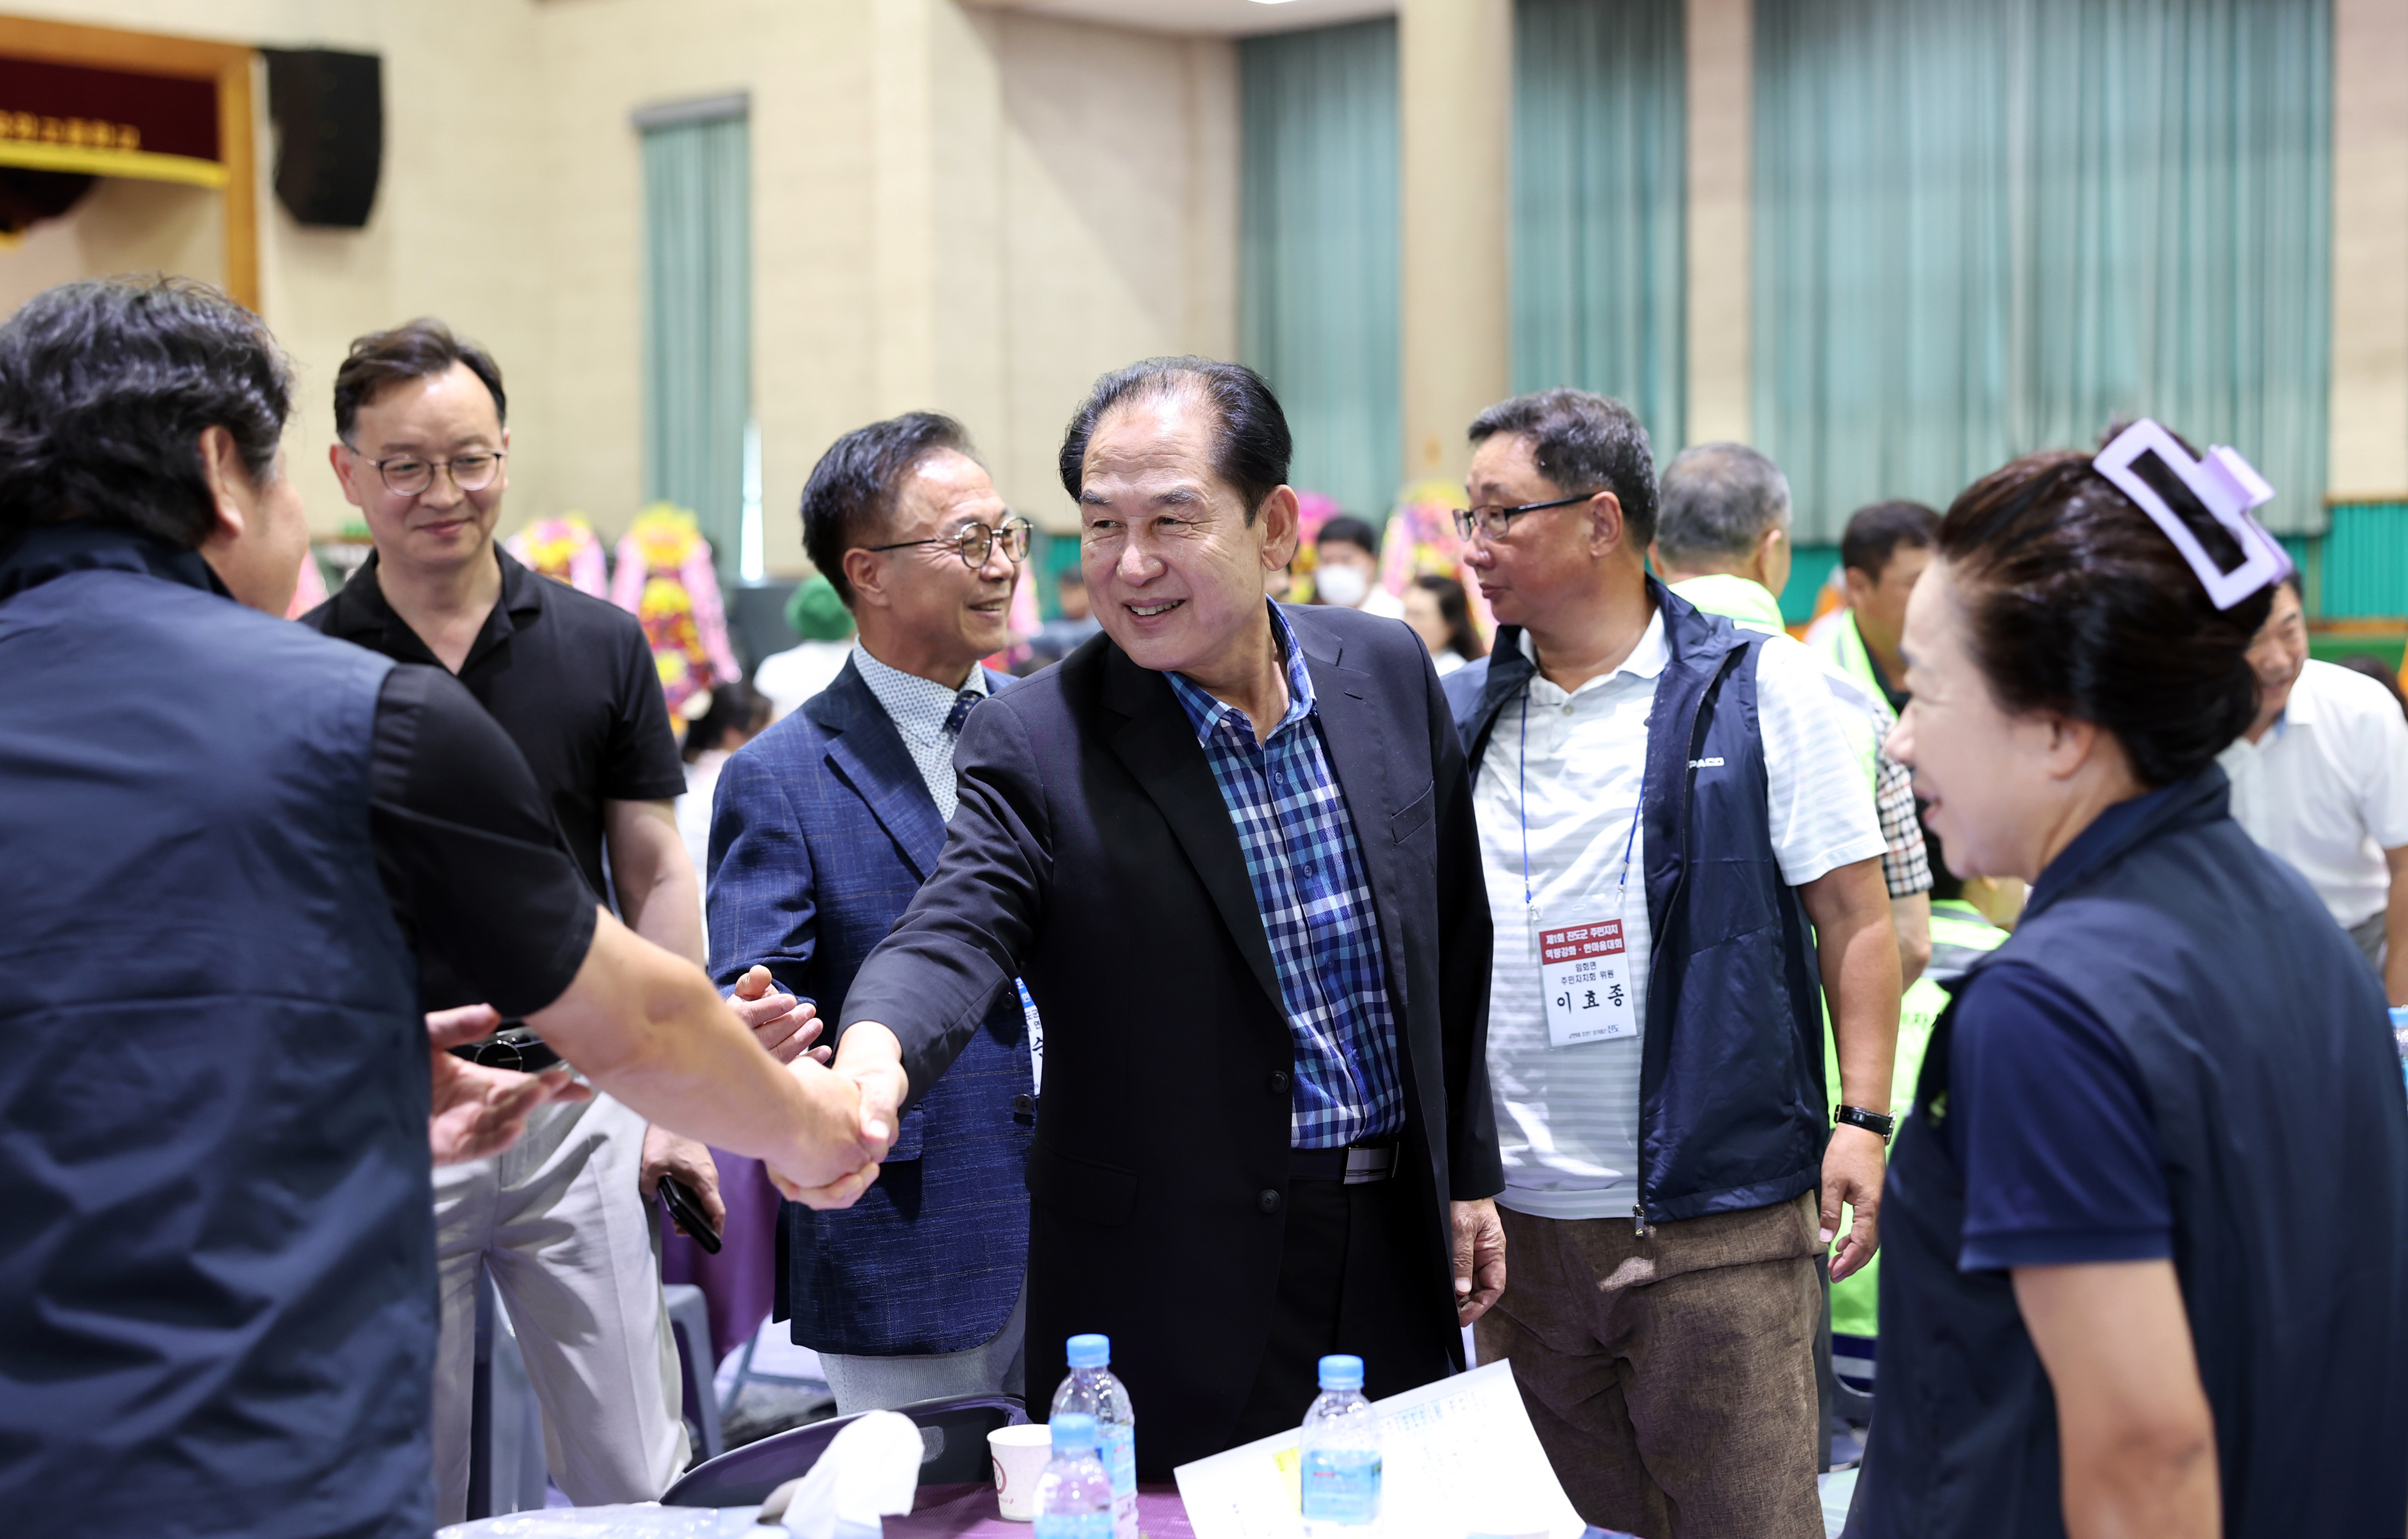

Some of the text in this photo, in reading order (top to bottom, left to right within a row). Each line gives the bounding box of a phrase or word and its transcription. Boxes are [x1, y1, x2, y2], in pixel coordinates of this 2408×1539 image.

[1546, 924, 1619, 945] 제1회 진도군 주민자치
[1545, 945, 1576, 959] 역량강화
[1583, 938, 1623, 954] 한마음대회
[1575, 961, 1597, 973] 임회면
[1561, 970, 1614, 985] 주민자치회 위원
